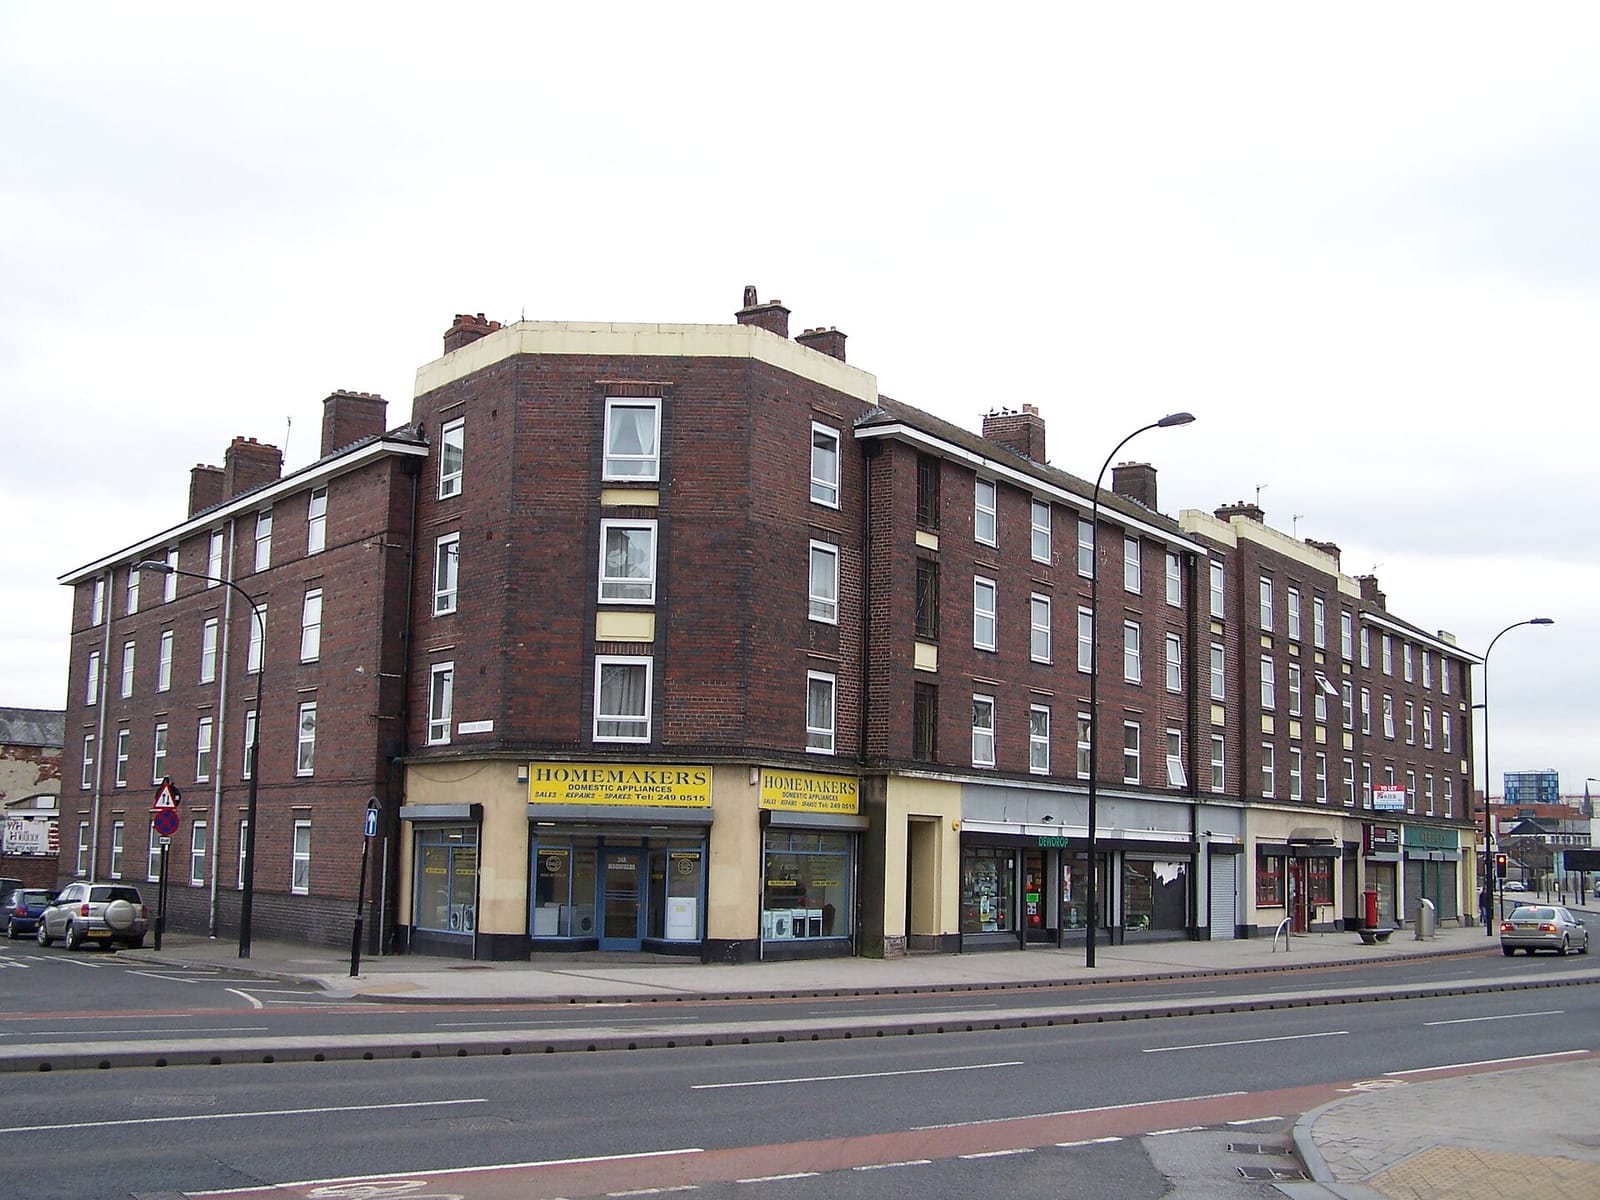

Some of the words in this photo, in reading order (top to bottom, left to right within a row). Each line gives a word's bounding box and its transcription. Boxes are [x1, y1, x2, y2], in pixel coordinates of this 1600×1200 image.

[536, 768, 706, 785] HOMEMAKERS
[616, 785, 673, 793] APPLIANCES
[764, 775, 856, 795] HOMEMAKERS
[679, 794, 705, 802] 0515
[782, 791, 808, 800] DOMESTIC
[808, 793, 838, 801] APPLIANCES
